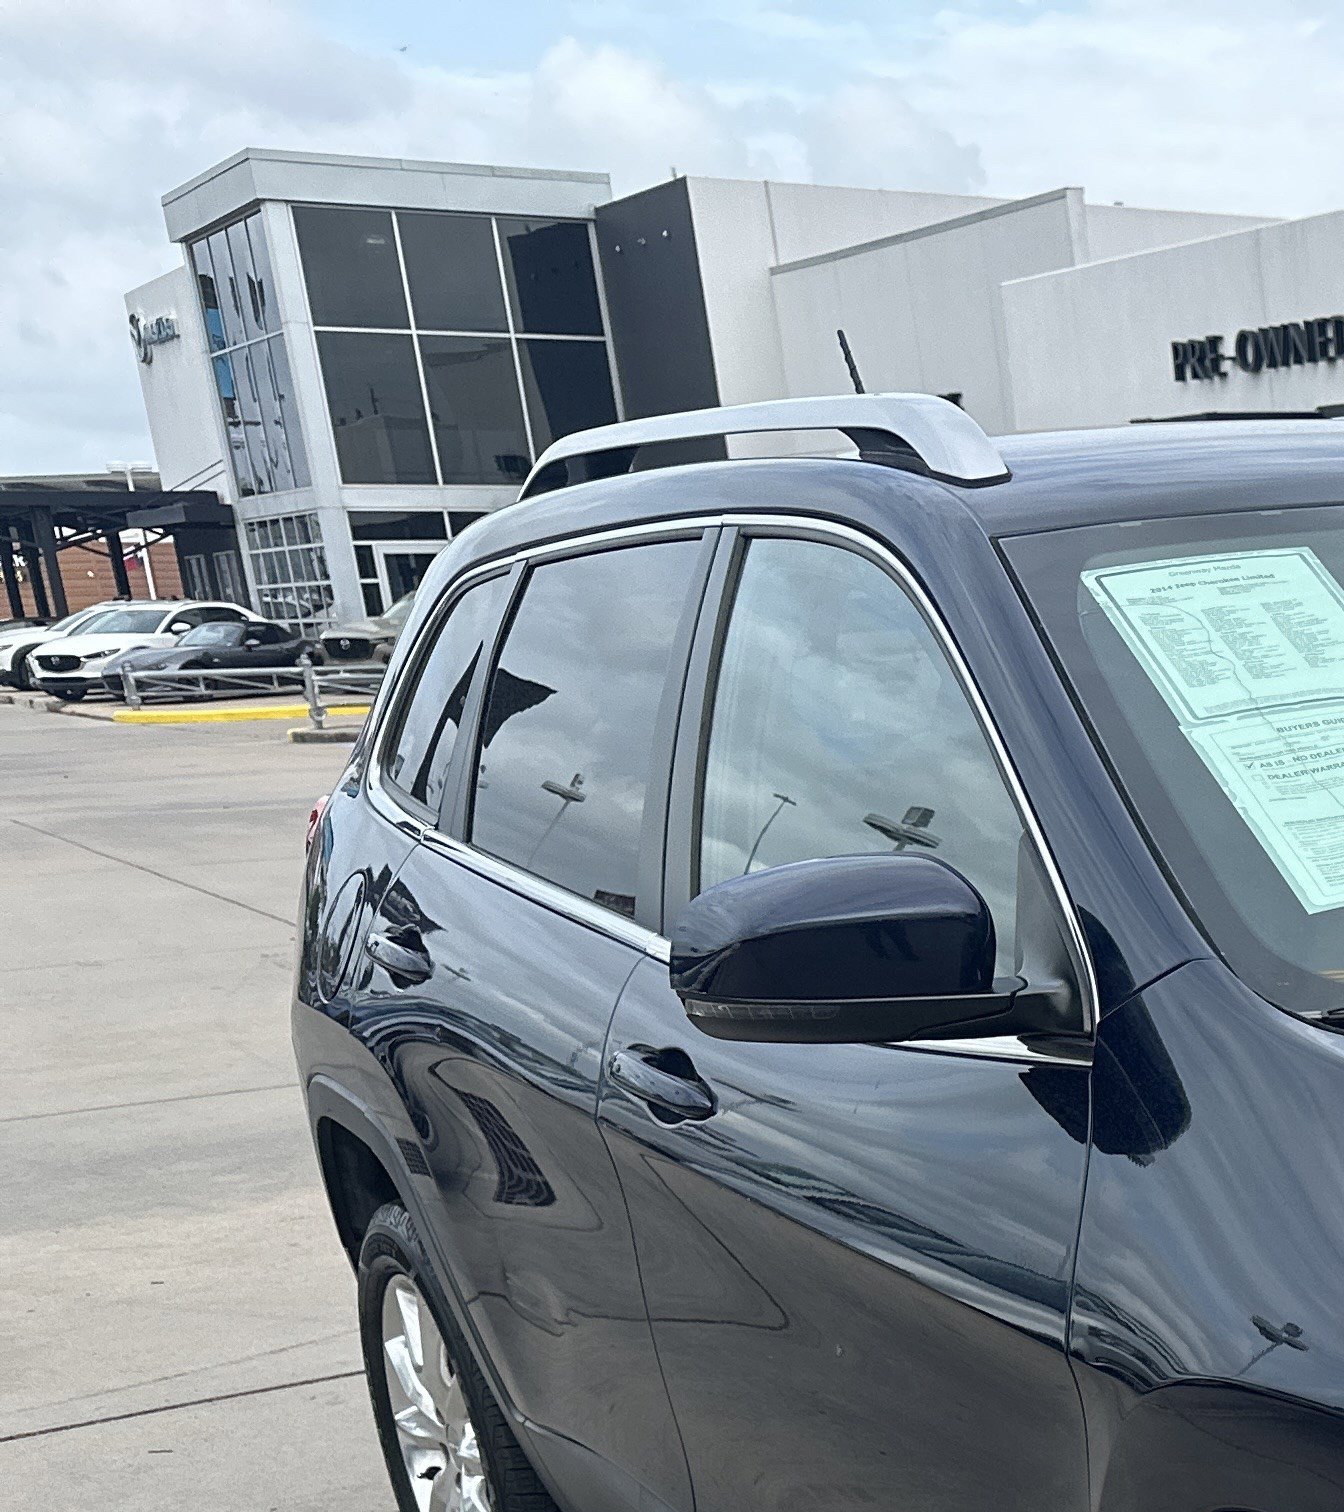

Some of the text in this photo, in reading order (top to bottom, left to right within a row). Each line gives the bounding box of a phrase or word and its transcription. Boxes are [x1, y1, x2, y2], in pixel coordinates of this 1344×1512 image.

[1150, 585, 1173, 594] 2014
[1175, 581, 1197, 590] Jeep
[1198, 577, 1240, 586] Cherokee
[1241, 573, 1276, 581] Limited
[1275, 721, 1320, 733] BUYERS
[1274, 759, 1286, 767] IS
[1292, 754, 1308, 763] NO
[1267, 770, 1310, 781] DEALER
